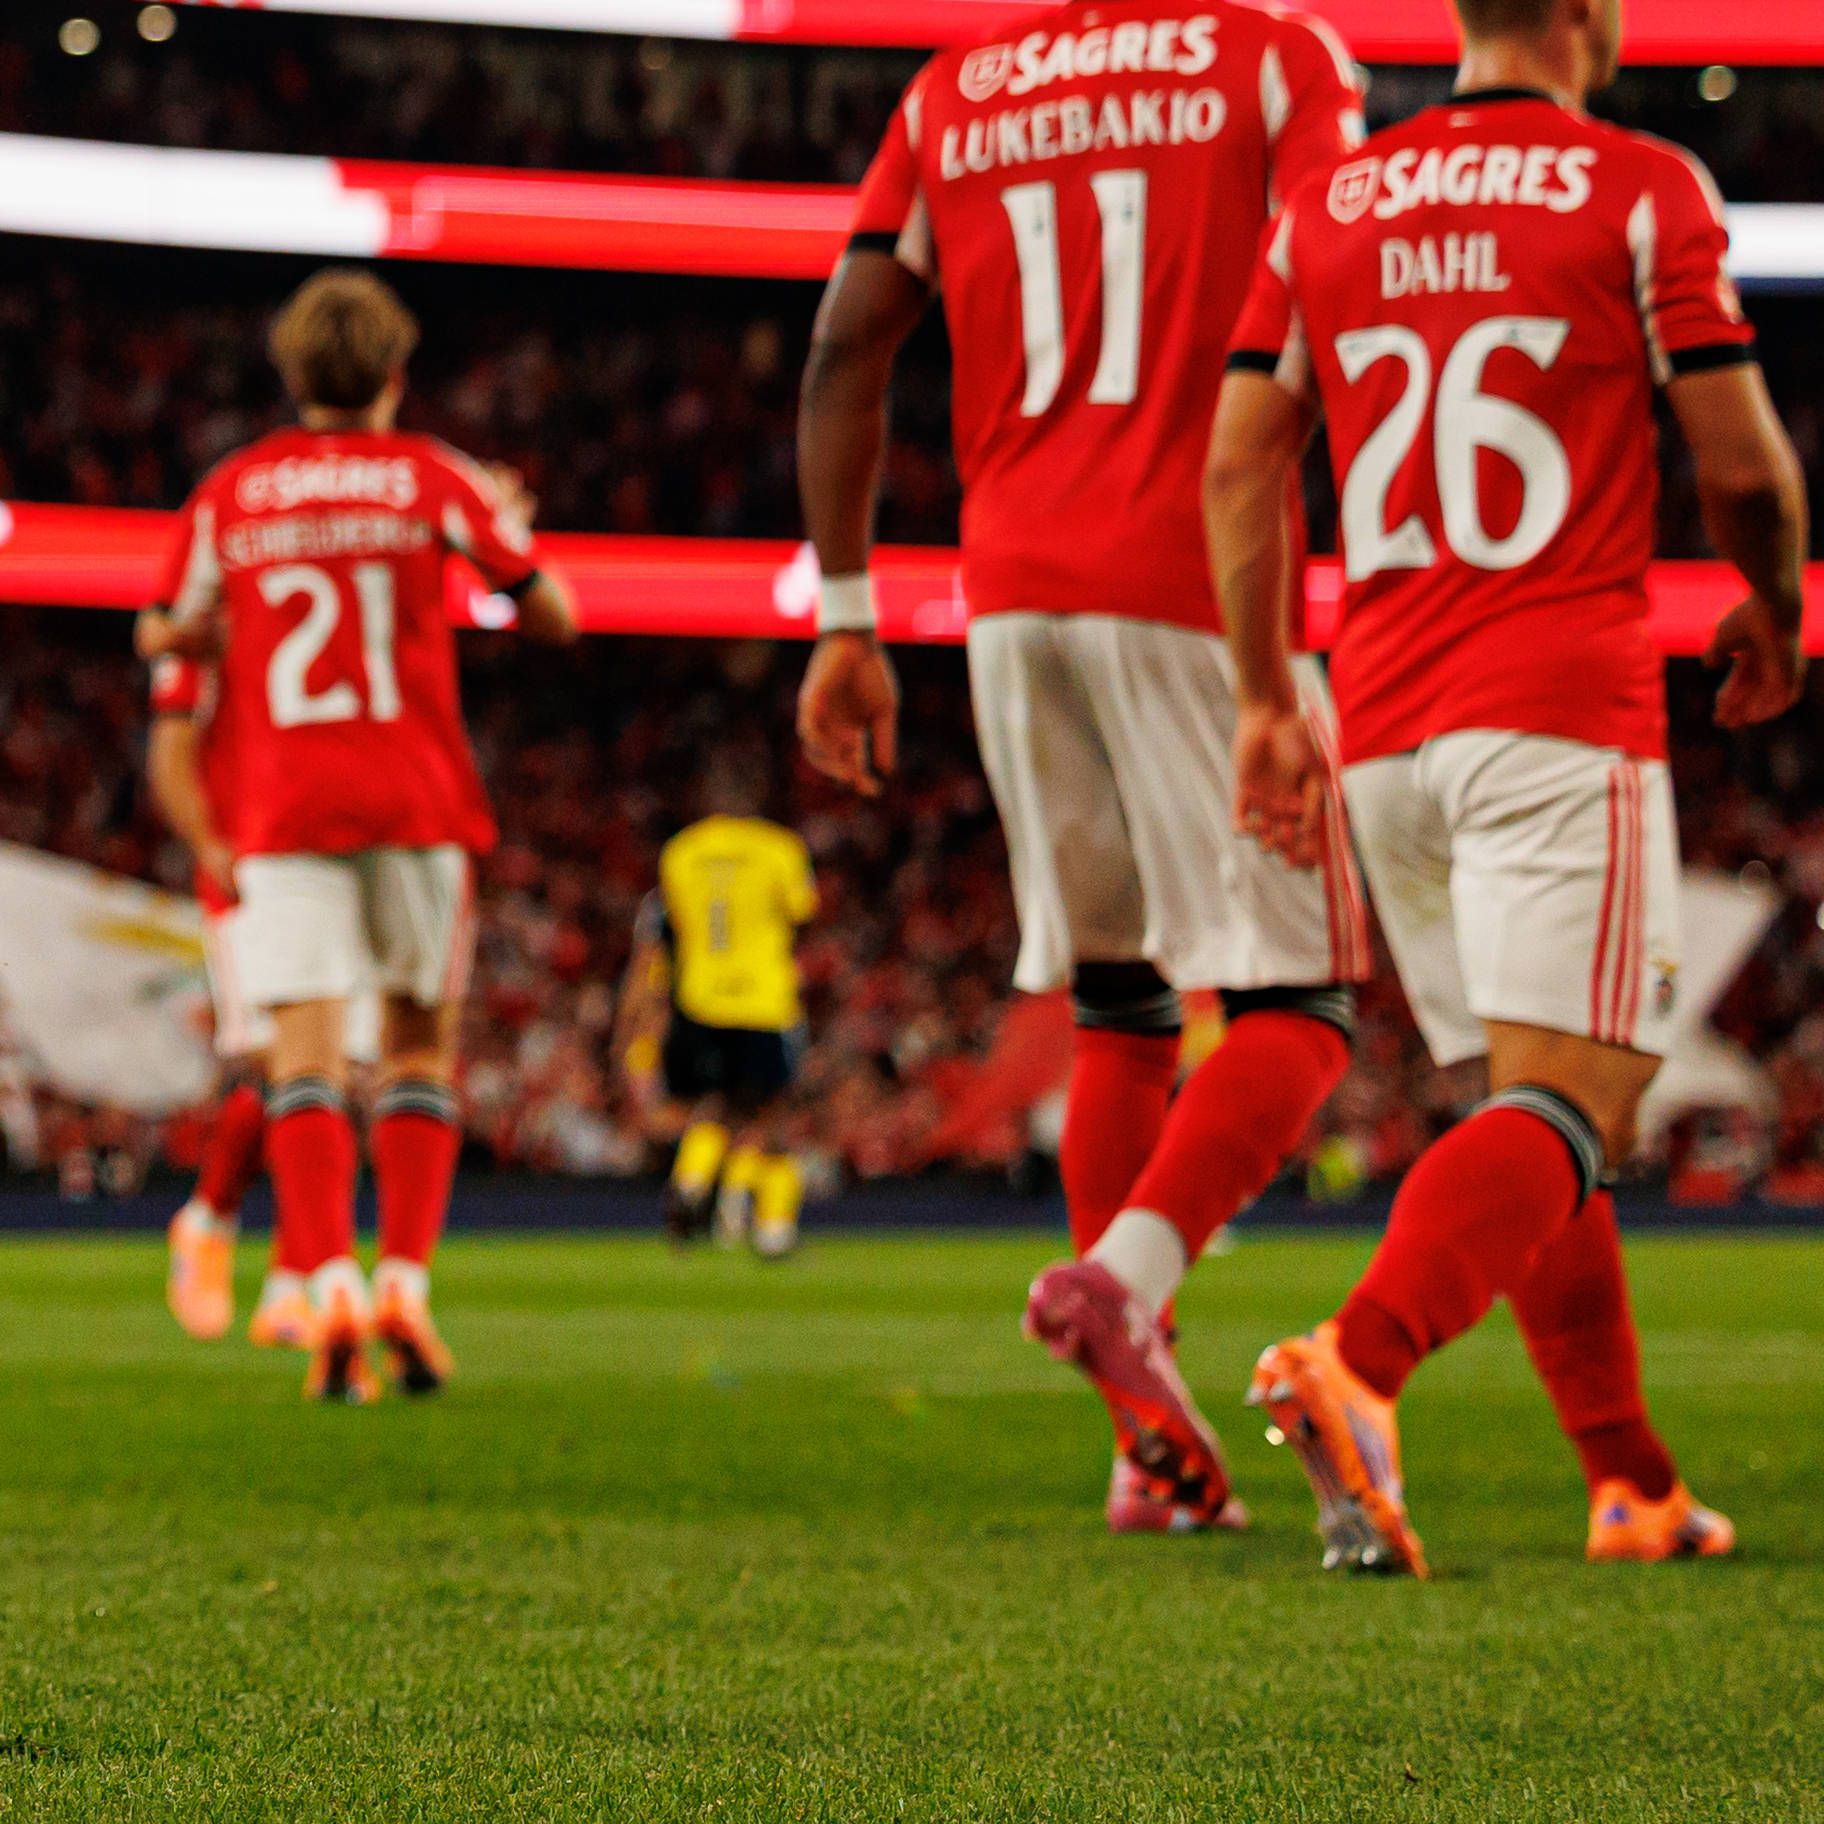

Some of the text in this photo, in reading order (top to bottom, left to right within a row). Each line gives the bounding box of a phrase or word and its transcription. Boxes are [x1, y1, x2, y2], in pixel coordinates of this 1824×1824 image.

[1006, 13, 1220, 98] SAGRES
[940, 87, 1227, 182] LUKEBAKIO
[1372, 143, 1599, 220] SAGRES
[1000, 170, 1148, 418] 11
[1380, 232, 1511, 301] DAHL
[1334, 316, 1573, 583] 26
[257, 560, 402, 729] 21
